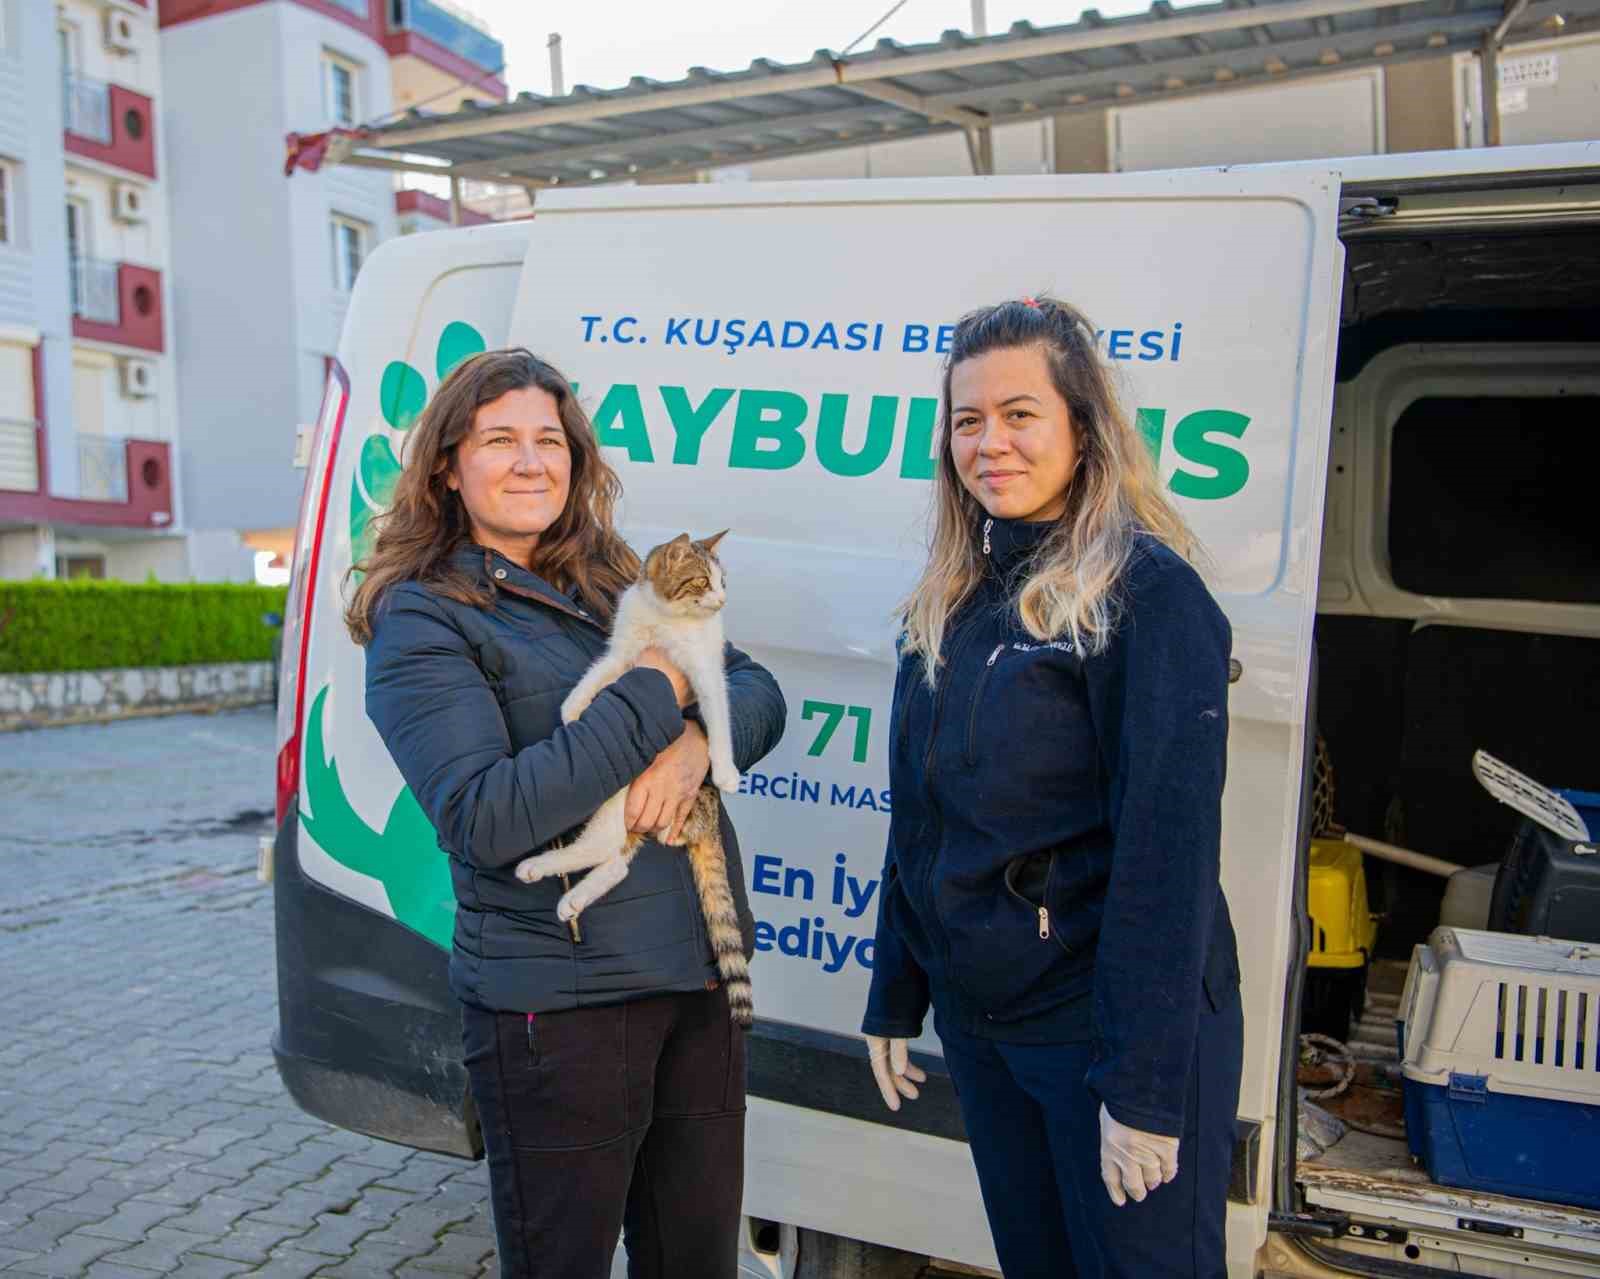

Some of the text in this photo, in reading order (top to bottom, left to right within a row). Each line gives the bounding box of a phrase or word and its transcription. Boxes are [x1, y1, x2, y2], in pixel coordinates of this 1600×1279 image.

[580, 316, 1183, 362] T.C. KUŞADASI BEESİ
[567, 382, 1252, 500] AYBULS
[801, 699, 873, 763] 71
[752, 854, 815, 901] En
